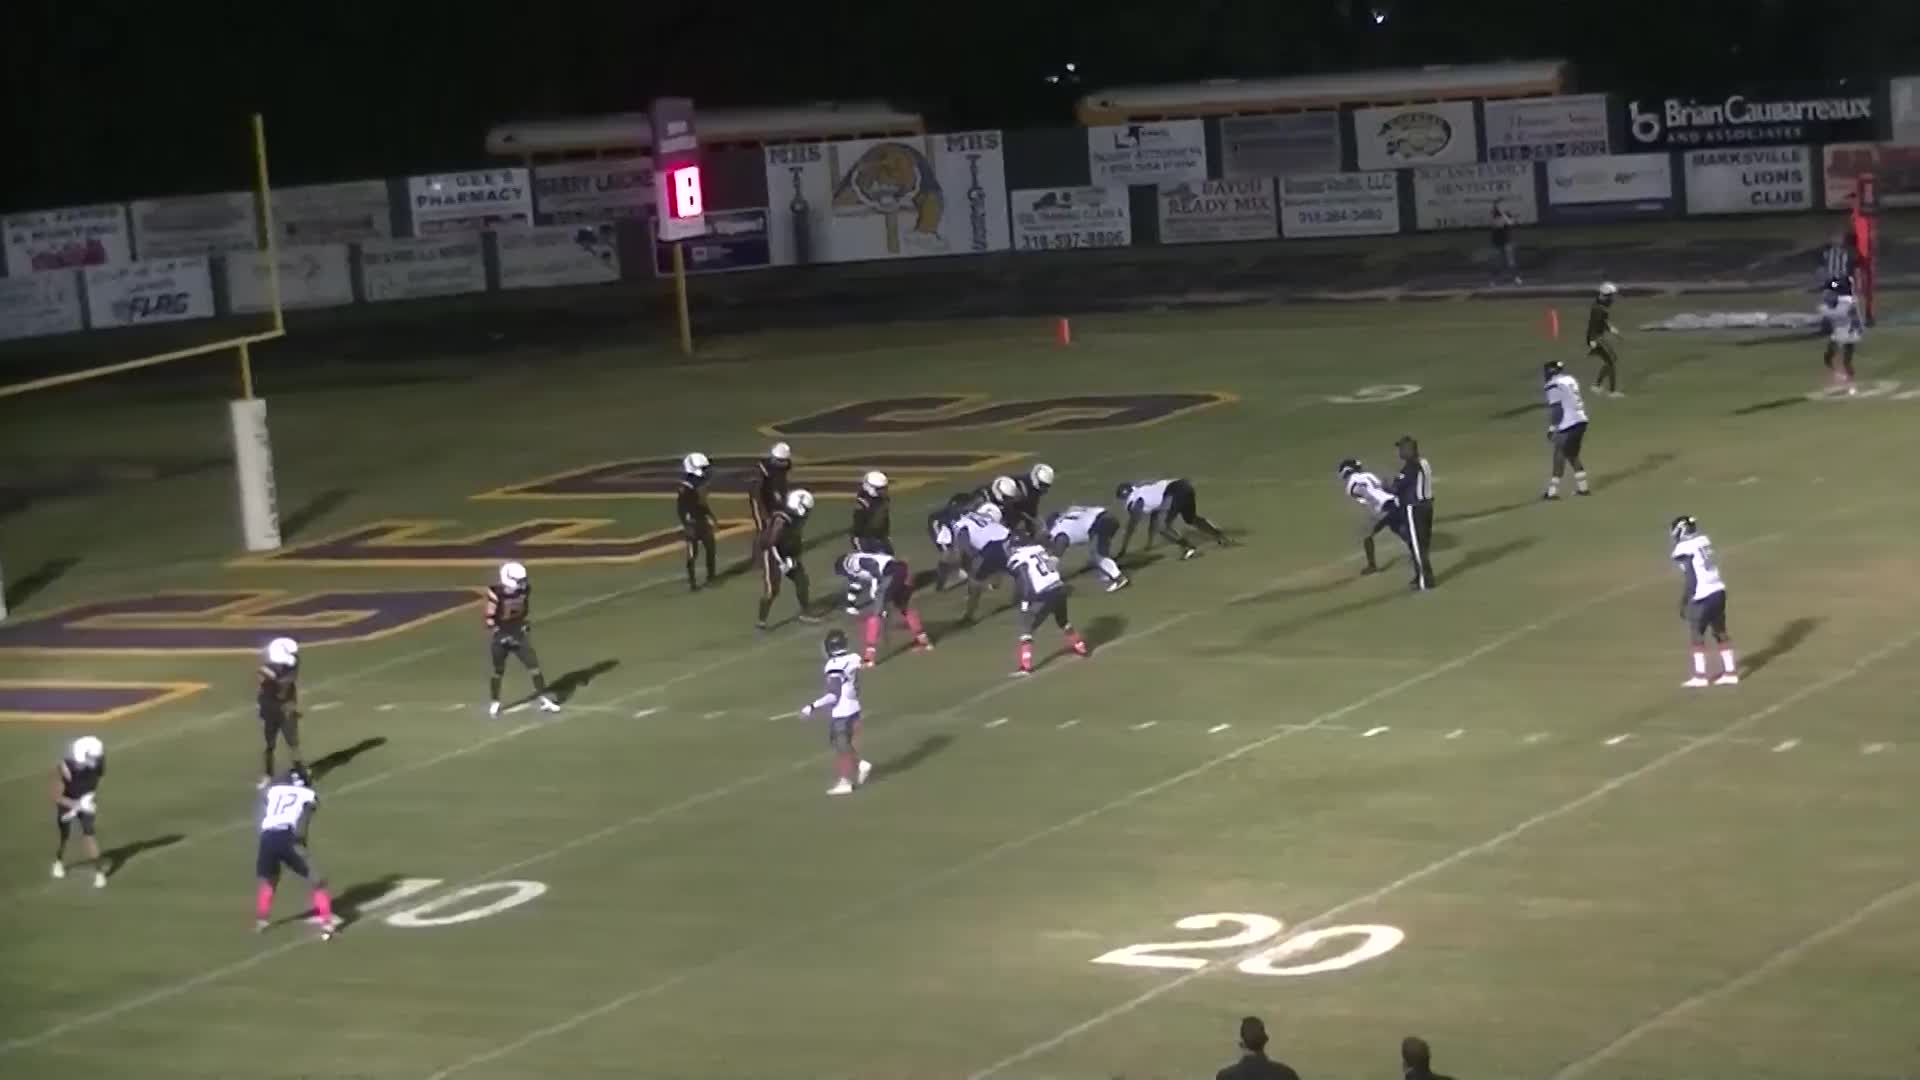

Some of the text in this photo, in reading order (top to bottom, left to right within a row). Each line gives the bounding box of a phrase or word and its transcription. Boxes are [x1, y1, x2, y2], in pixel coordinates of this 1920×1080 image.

[1664, 98, 1724, 127] Brian
[1667, 128, 1802, 143] AND ASSOCIATES
[1693, 152, 1801, 166] MARKSVILLE
[1742, 170, 1803, 186] LIONS
[416, 188, 523, 208] PHARMACY
[1168, 199, 1229, 215] READY
[1235, 197, 1271, 211] MIX
[1751, 190, 1803, 206] CLUB
[273, 792, 299, 816] 12
[306, 878, 548, 927] 10
[1089, 911, 1406, 976] 20
